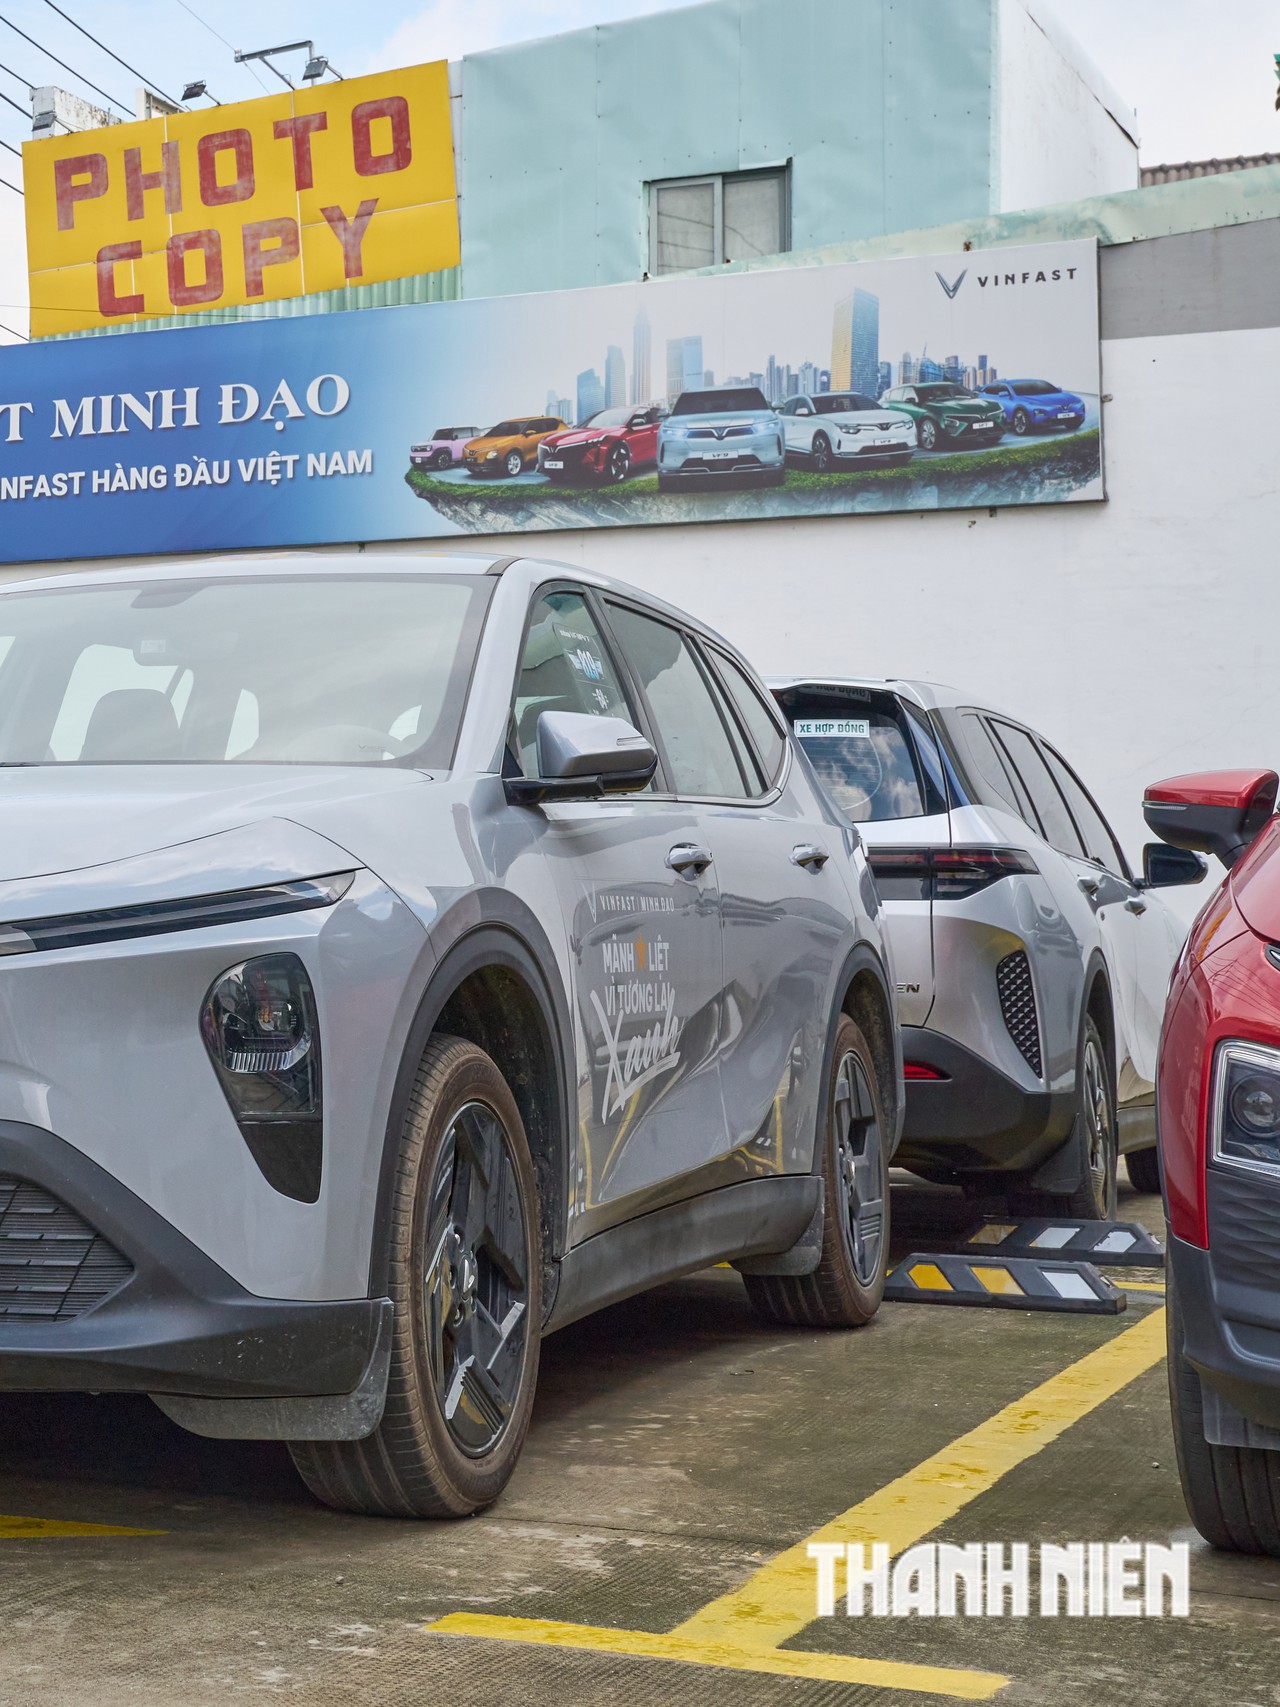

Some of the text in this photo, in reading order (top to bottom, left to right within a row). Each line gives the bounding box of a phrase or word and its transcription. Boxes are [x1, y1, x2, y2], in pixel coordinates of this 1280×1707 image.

[54, 95, 412, 231] PHOTO
[96, 197, 379, 318] COPY
[977, 268, 1077, 288] VINFAST
[50, 386, 200, 438] MINH
[217, 374, 350, 431] ĐẠO
[92, 462, 168, 494] HÀNG
[174, 455, 231, 488] ĐẦU
[237, 450, 300, 486] VIỆT
[306, 449, 373, 477] NAM
[799, 724, 812, 733] XE
[815, 723, 835, 735] HỢP
[600, 895, 636, 911] VINFAST
[640, 897, 660, 912] MINH
